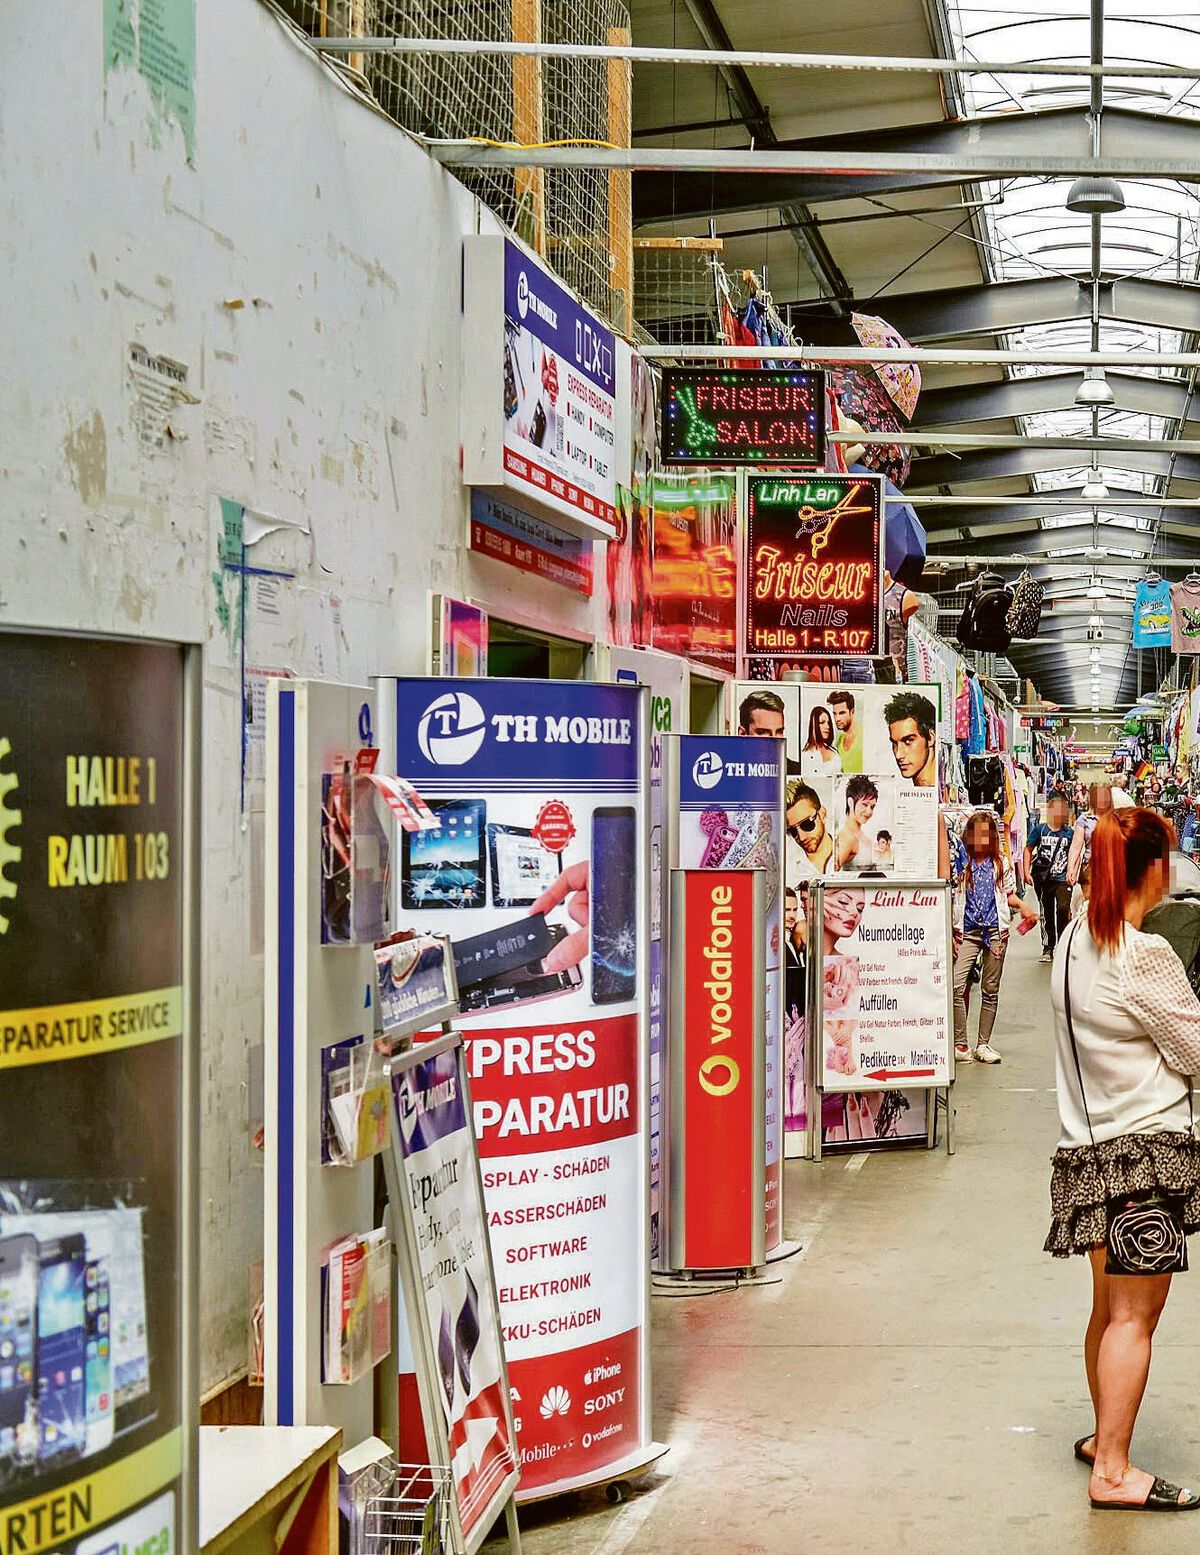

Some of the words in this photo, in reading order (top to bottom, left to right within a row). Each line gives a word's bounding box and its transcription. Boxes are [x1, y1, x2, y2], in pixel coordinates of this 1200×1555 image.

[696, 386, 810, 412] FRISEUR
[716, 420, 807, 446] SALON
[760, 485, 800, 502] Linh
[804, 485, 840, 502] Lan
[755, 545, 870, 600] Friseur
[780, 604, 848, 627] Nails
[755, 631, 797, 646] Halle
[801, 631, 809, 646] 1
[492, 714, 538, 744] TH
[544, 716, 631, 745] MOBILE
[66, 755, 141, 808] HALLE
[147, 757, 157, 806] 1
[725, 762, 745, 777] TH
[48, 834, 128, 888] RAUM
[135, 832, 170, 881] 103
[870, 889, 904, 907] Linh
[909, 889, 937, 907] Lan
[858, 923, 925, 945] Neumodellage
[703, 884, 733, 1044] vodafone
[859, 993, 898, 1011] Auffüllen
[0, 1013, 103, 1055] PARATUR
[108, 1001, 169, 1038] SERVICE
[860, 1051, 897, 1068] Pediküre
[910, 1050, 938, 1066] Maniküre
[473, 1083, 630, 1139] PARATUR
[483, 1168, 539, 1188] SPLAY
[553, 1155, 611, 1180] SCHÄDEN
[506, 1236, 588, 1264] SOFTWARE
[499, 1273, 592, 1304] ELEKTRONIK
[593, 1363, 622, 1383] iPhone
[584, 1387, 626, 1416] SONY
[592, 1422, 624, 1443] vodafone
[6, 1484, 92, 1555] RTEN
